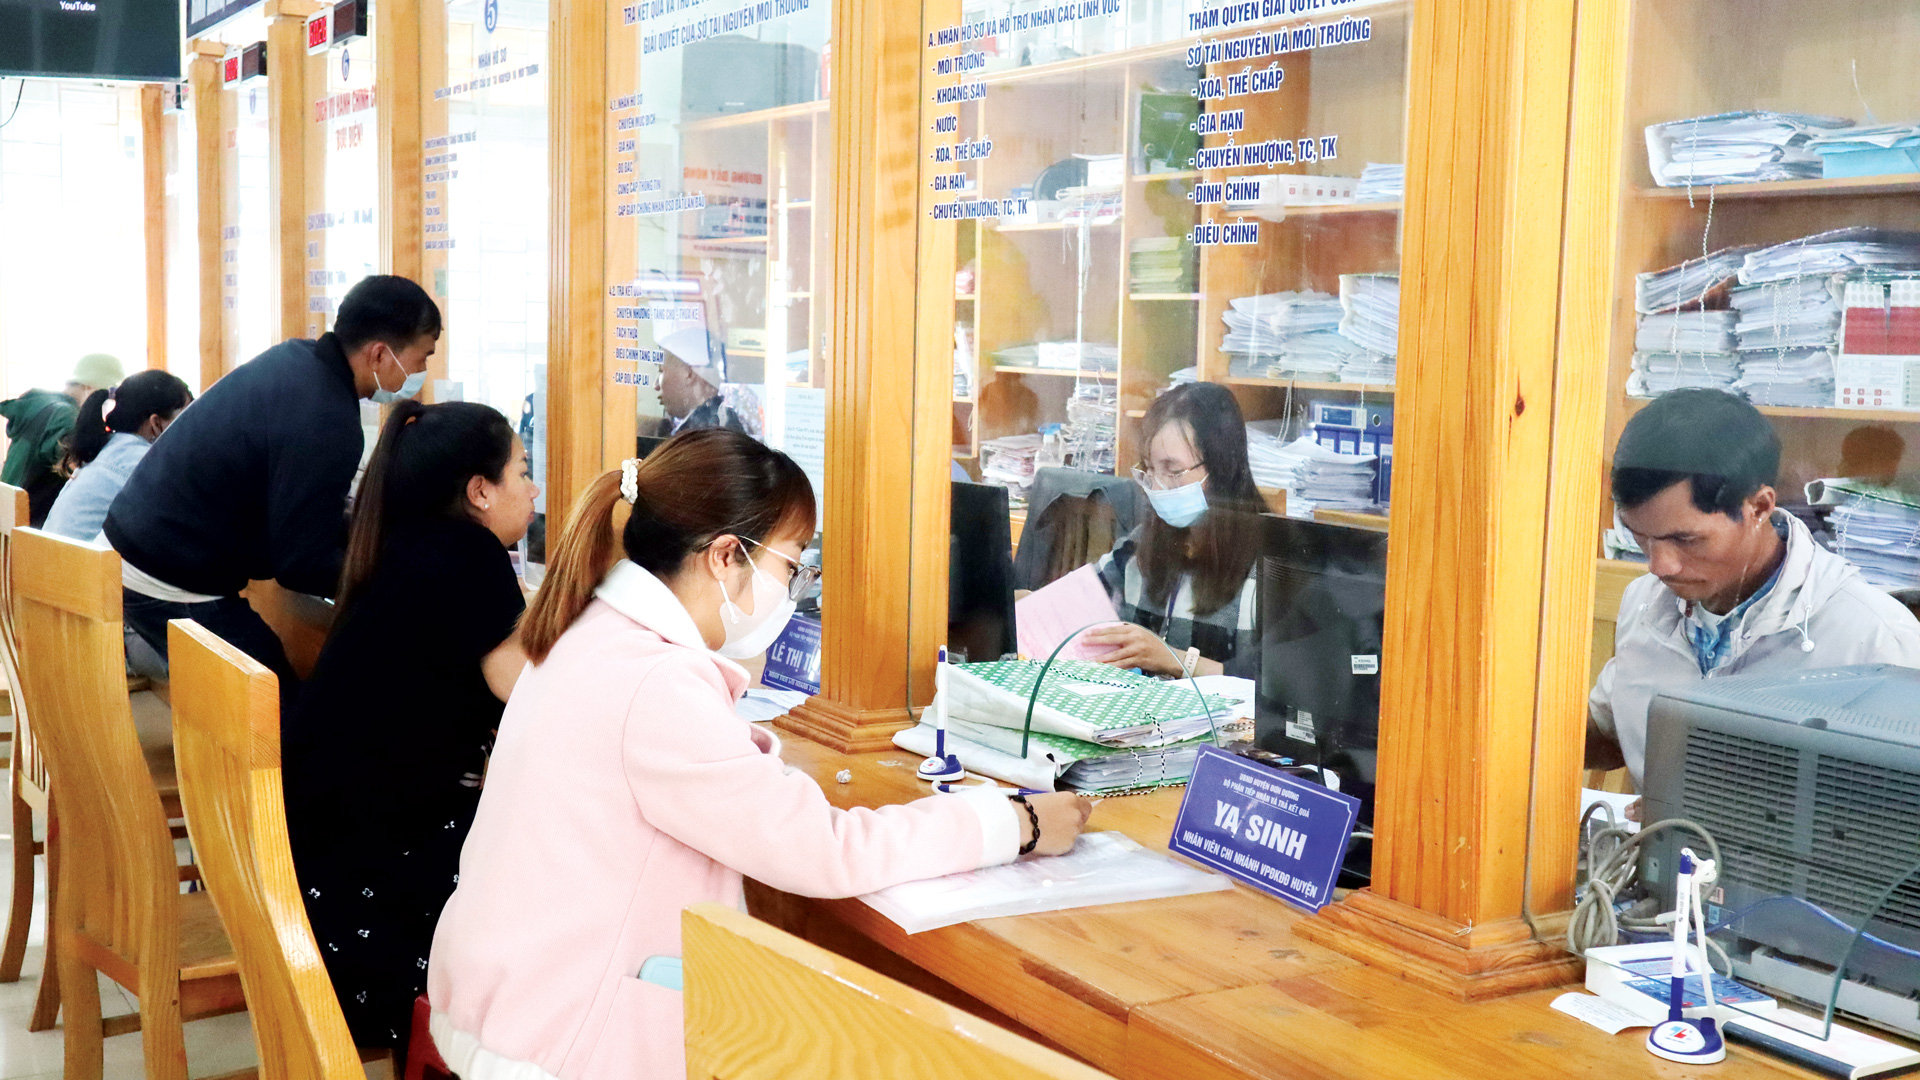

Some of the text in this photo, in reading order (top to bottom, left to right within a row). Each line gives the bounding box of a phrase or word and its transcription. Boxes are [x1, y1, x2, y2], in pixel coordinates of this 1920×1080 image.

[60, 1, 96, 11] YouTube
[1189, 2, 1219, 31] THẨM
[937, 25, 959, 47] NHẬN
[974, 21, 985, 38] SƠ
[987, 17, 997, 36] VÀ
[1013, 14, 1028, 32] TRỢ
[1030, 6, 1055, 29] NHẬN
[1057, 2, 1075, 23] CÁC
[1187, 17, 1370, 66] SỞ TÀI NGUYÊN VÀ MÔI TRƯỜNG
[937, 50, 985, 75] MÔI TRƯỜNG
[937, 78, 987, 104] KHOÁNG SẢN
[1200, 62, 1283, 99] XÓA, THẾ CHẤP
[936, 113, 957, 133] NƯỚC
[1198, 111, 1243, 135] GIA HẠN
[955, 138, 968, 160] THẾ
[970, 135, 992, 158] CHẤP
[1197, 137, 1336, 168] CHUYỂN NHƯỢNG, TC, TK
[934, 174, 965, 193] GIA HẠN
[1195, 178, 1260, 203] ĐÍNH CHÍNH
[933, 197, 964, 219] CHUYỂN
[1003, 199, 1015, 216] TC,
[1018, 199, 1028, 214] TK
[1195, 218, 1257, 244] ĐIỀU CHỈNH
[771, 641, 786, 662] LÊ
[785, 647, 803, 672] THỊ
[1288, 803, 1299, 813] KẾT
[1245, 814, 1308, 861] SINH
[1183, 830, 1204, 848] NHÂN
[1203, 839, 1220, 856] VIÊN
[1220, 846, 1234, 861] CHI
[1233, 852, 1260, 873] NHÁNH
[1290, 876, 1318, 898] HUYỆN
